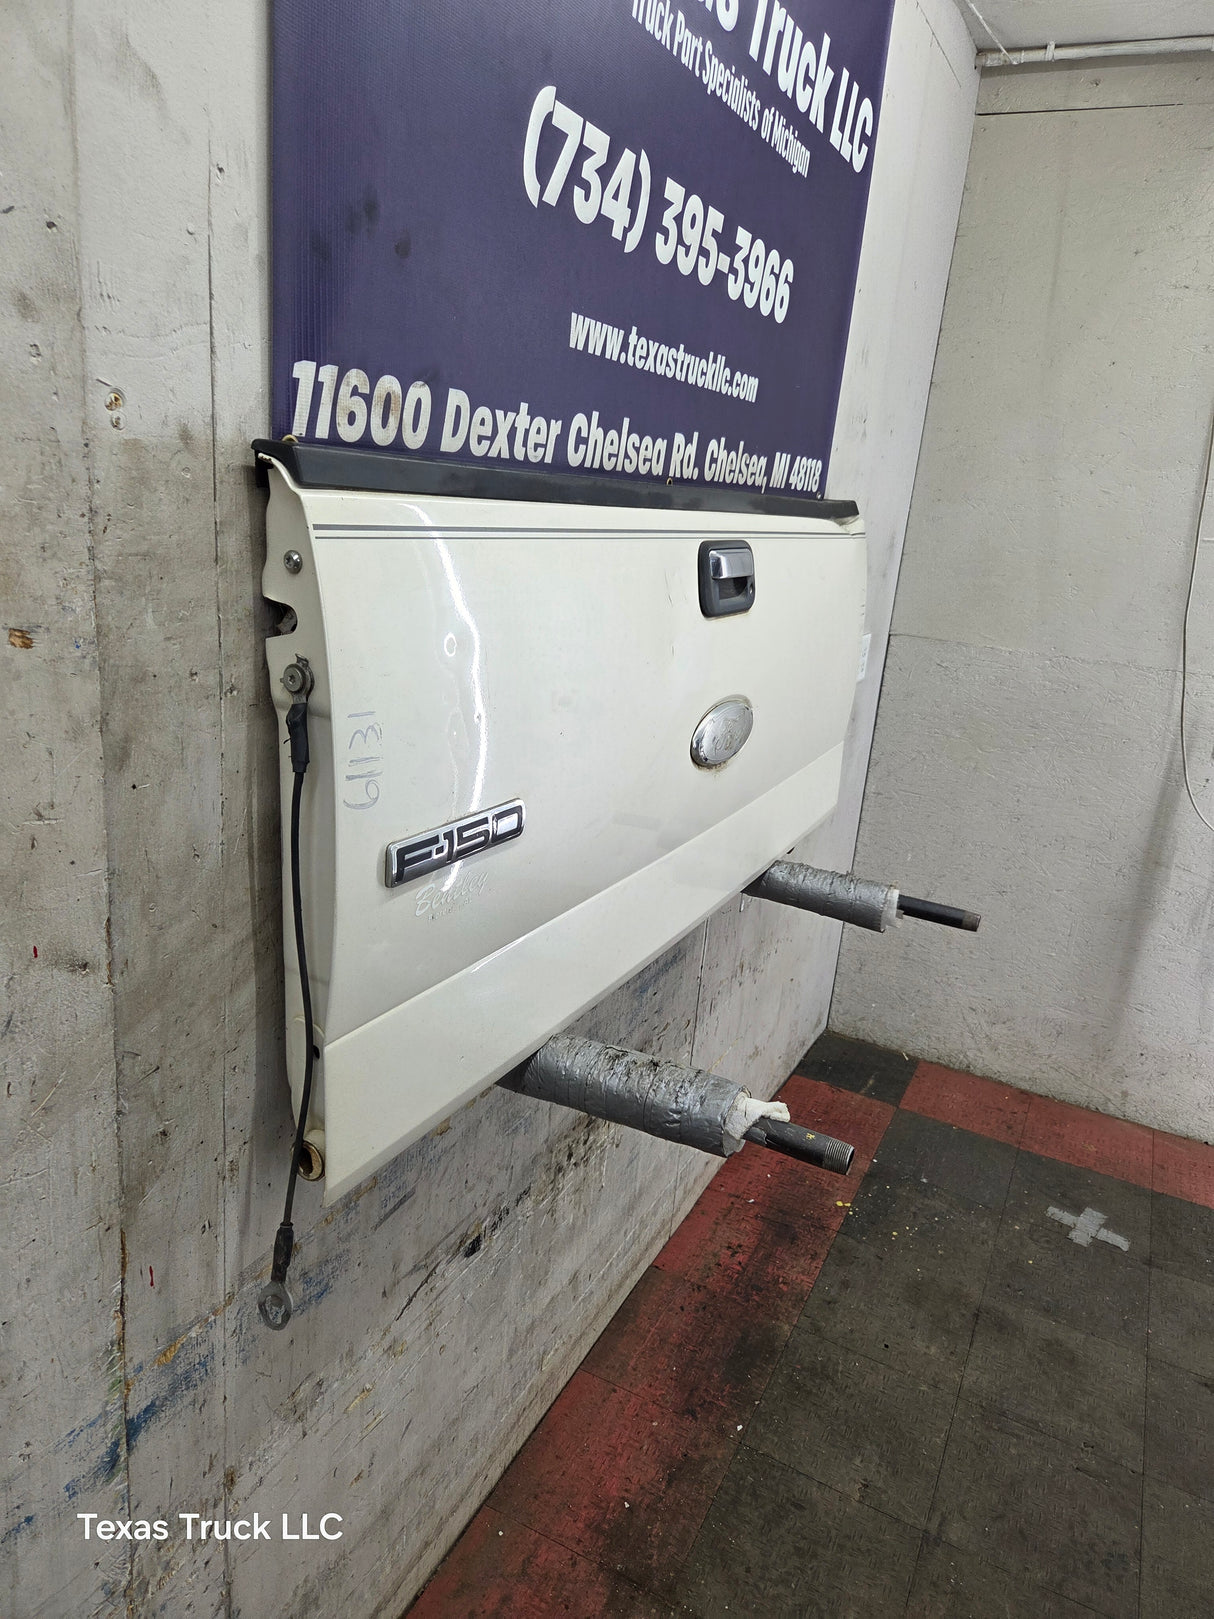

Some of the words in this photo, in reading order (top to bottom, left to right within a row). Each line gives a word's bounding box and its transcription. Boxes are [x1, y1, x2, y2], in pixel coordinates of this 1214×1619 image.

[673, 9, 704, 78] Part
[702, 40, 760, 131] Specialists
[761, 106, 775, 142] of
[770, 110, 810, 178] Michigan
[829, 67, 874, 173] LLC
[523, 85, 651, 253] (734)
[655, 177, 794, 324] 395-3966
[569, 312, 759, 403] www.texastruckllc.com
[292, 360, 432, 450] 11600
[440, 387, 563, 464] Dexter
[567, 410, 667, 476] Chelsea
[668, 431, 699, 480] Rd.
[704, 437, 767, 494] Chelsea,
[769, 452, 791, 489] MI
[788, 456, 822, 492] 48118
[343, 711, 384, 810] 61131
